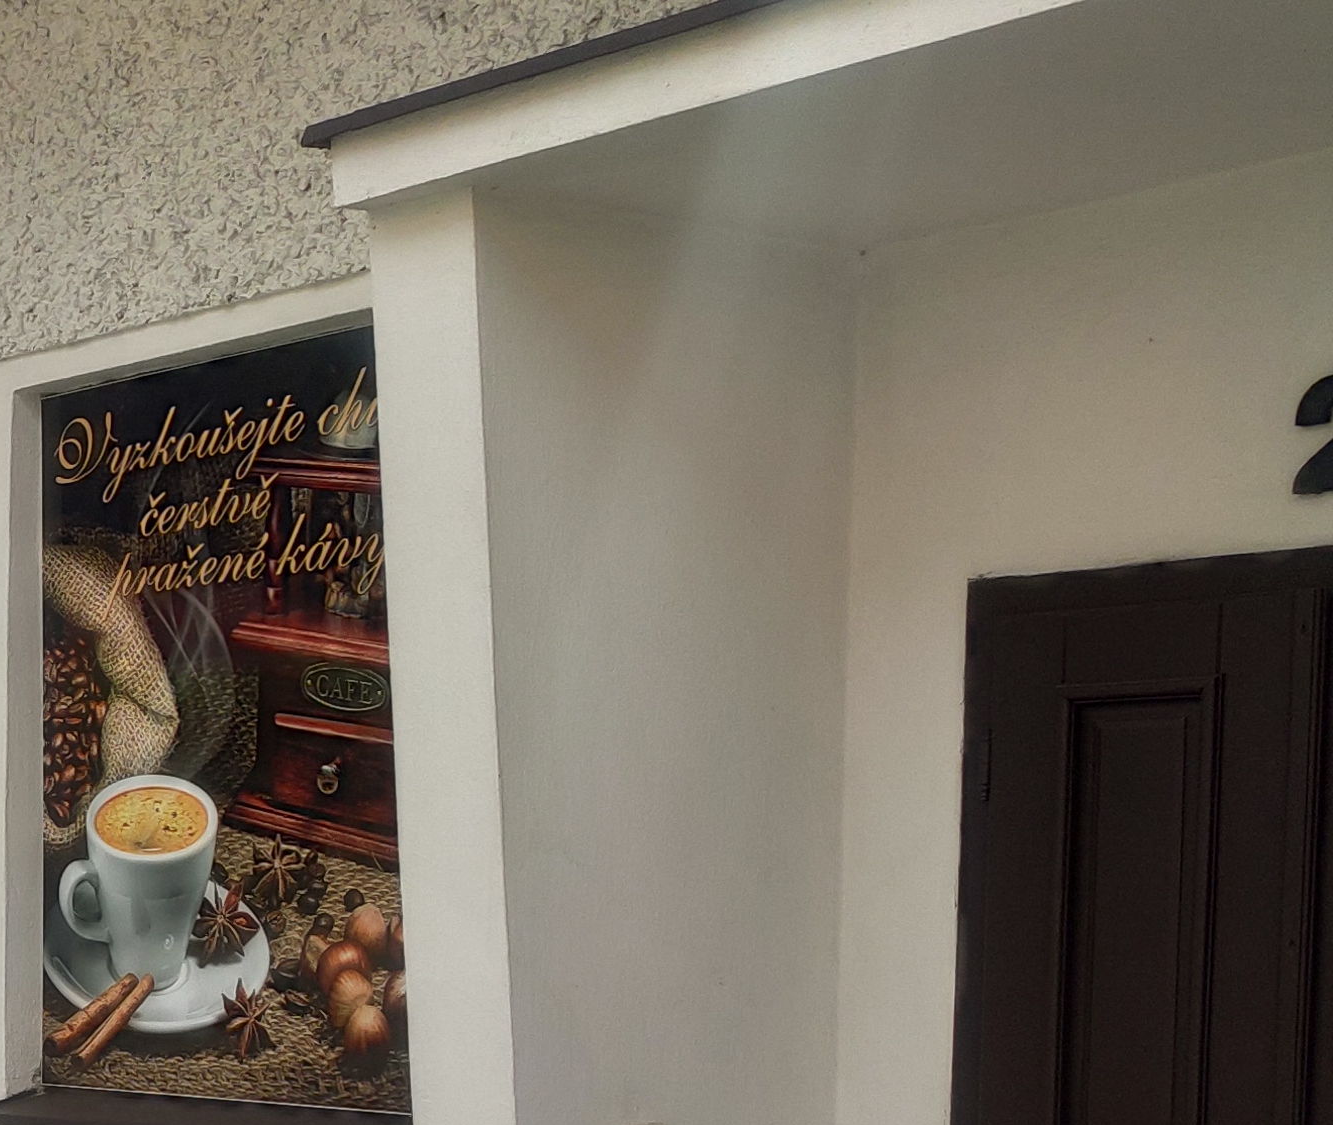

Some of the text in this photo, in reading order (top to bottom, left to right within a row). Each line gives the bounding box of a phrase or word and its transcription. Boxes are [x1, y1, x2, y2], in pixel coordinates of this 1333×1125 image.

[54, 394, 306, 503] Vyzkoušejte
[139, 471, 280, 539] čerstvě
[100, 513, 386, 623] pražené kávy
[315, 673, 375, 705] CAFE
